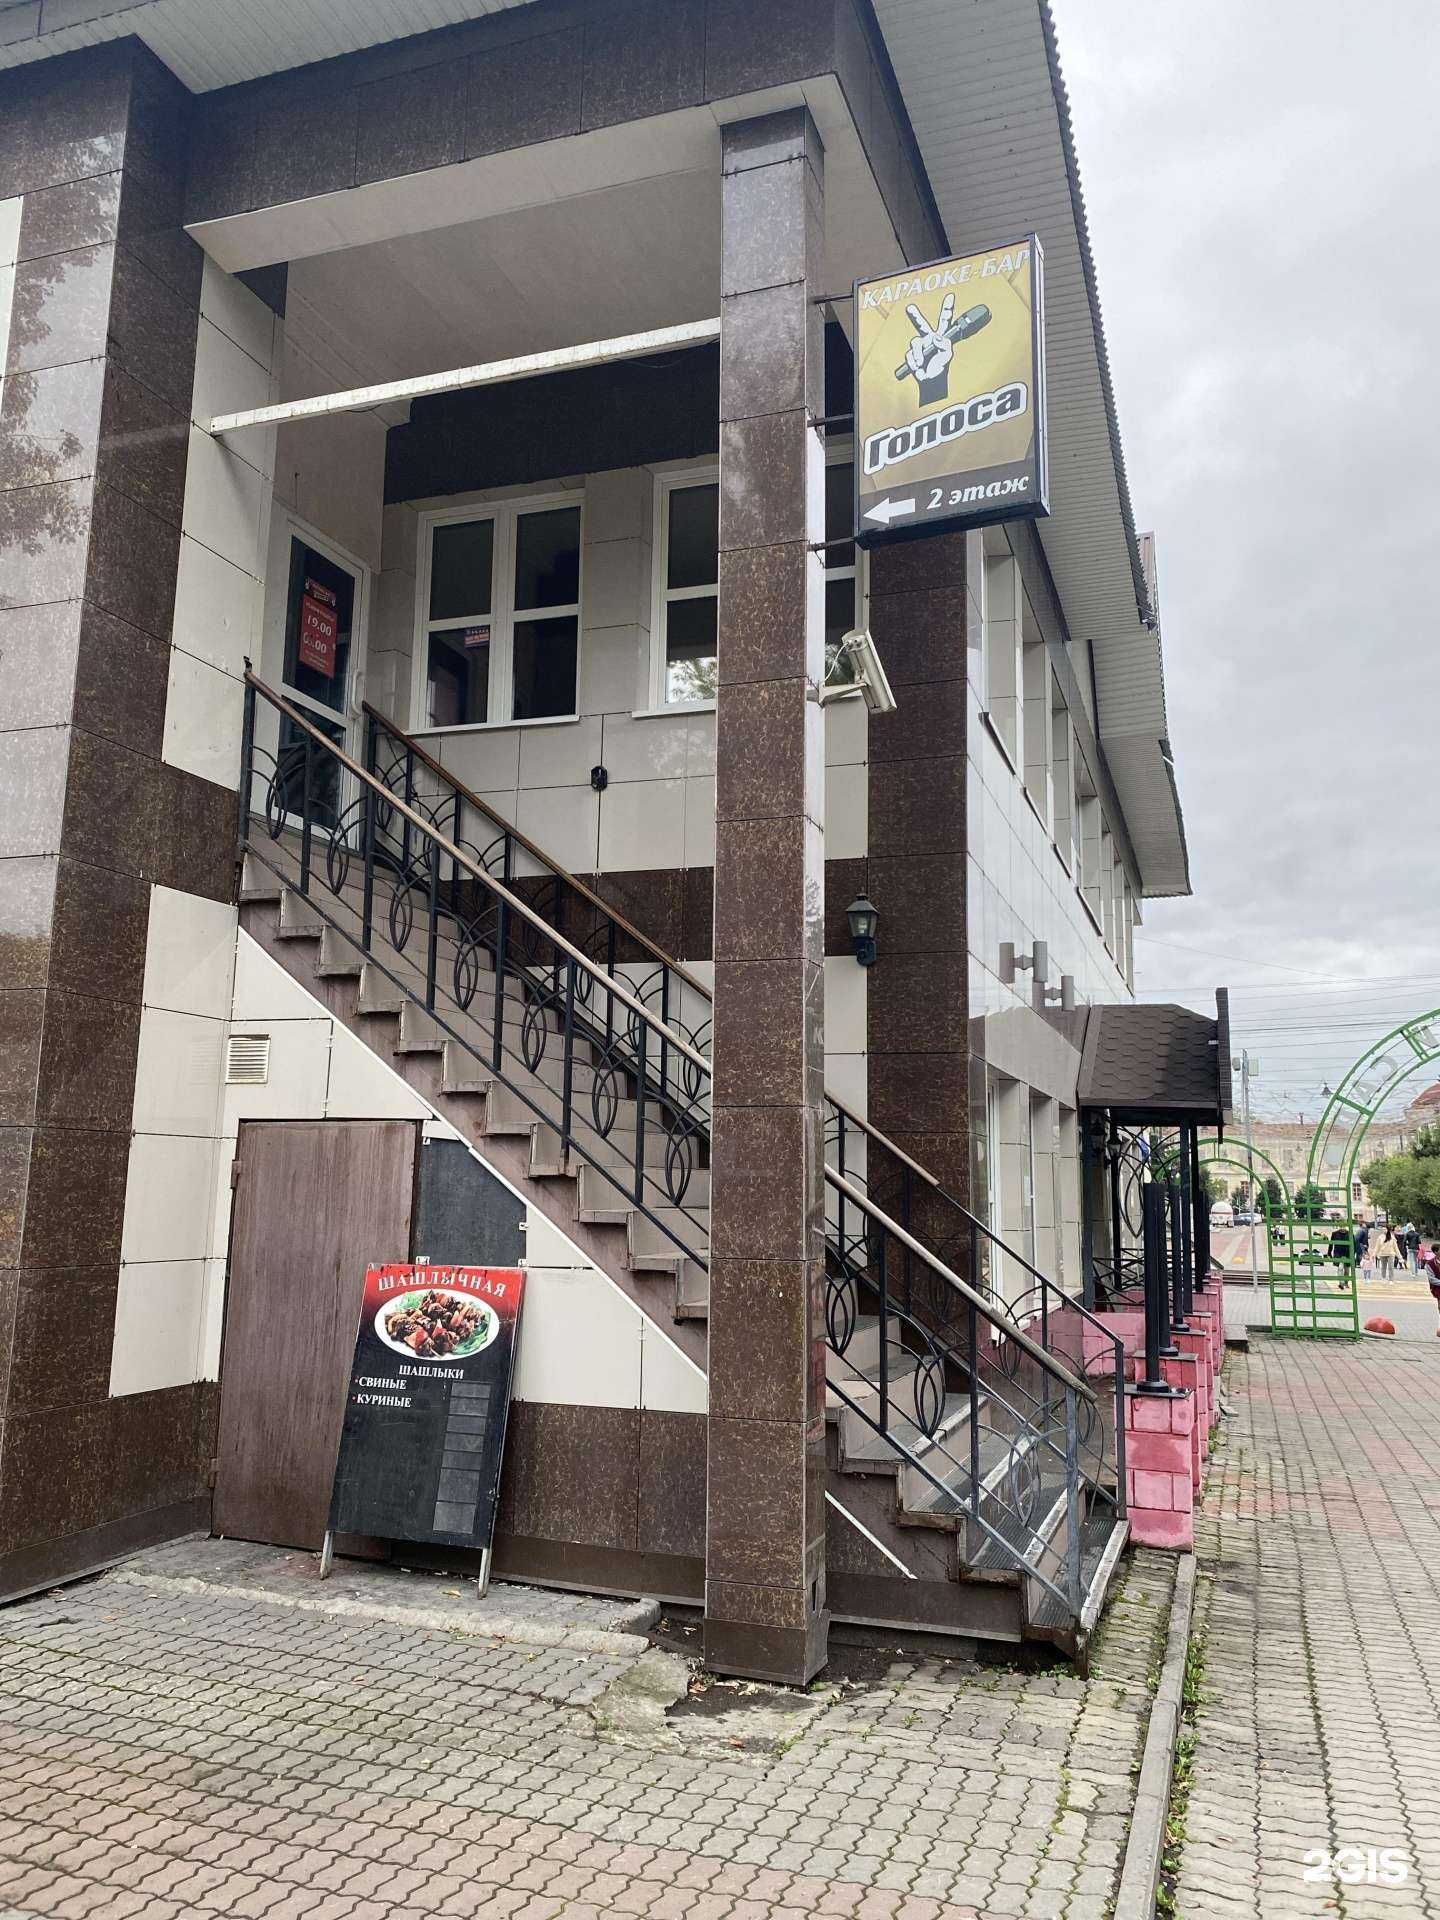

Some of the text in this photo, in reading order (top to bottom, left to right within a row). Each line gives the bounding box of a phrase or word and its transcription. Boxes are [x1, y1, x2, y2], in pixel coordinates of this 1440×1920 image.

[863, 249, 1030, 309] КАРАОКЕ-БАР
[866, 384, 1026, 473] Голоса
[926, 475, 1030, 510] 2 этаж
[307, 615, 332, 637] 19.00
[378, 1271, 506, 1298] ШАШЛЫЧНАЯ
[358, 1376, 407, 1390] СВИНЫЕ
[398, 1364, 465, 1380] ШАШЛЫКИ
[356, 1393, 412, 1408] КУРИНЫЕ
